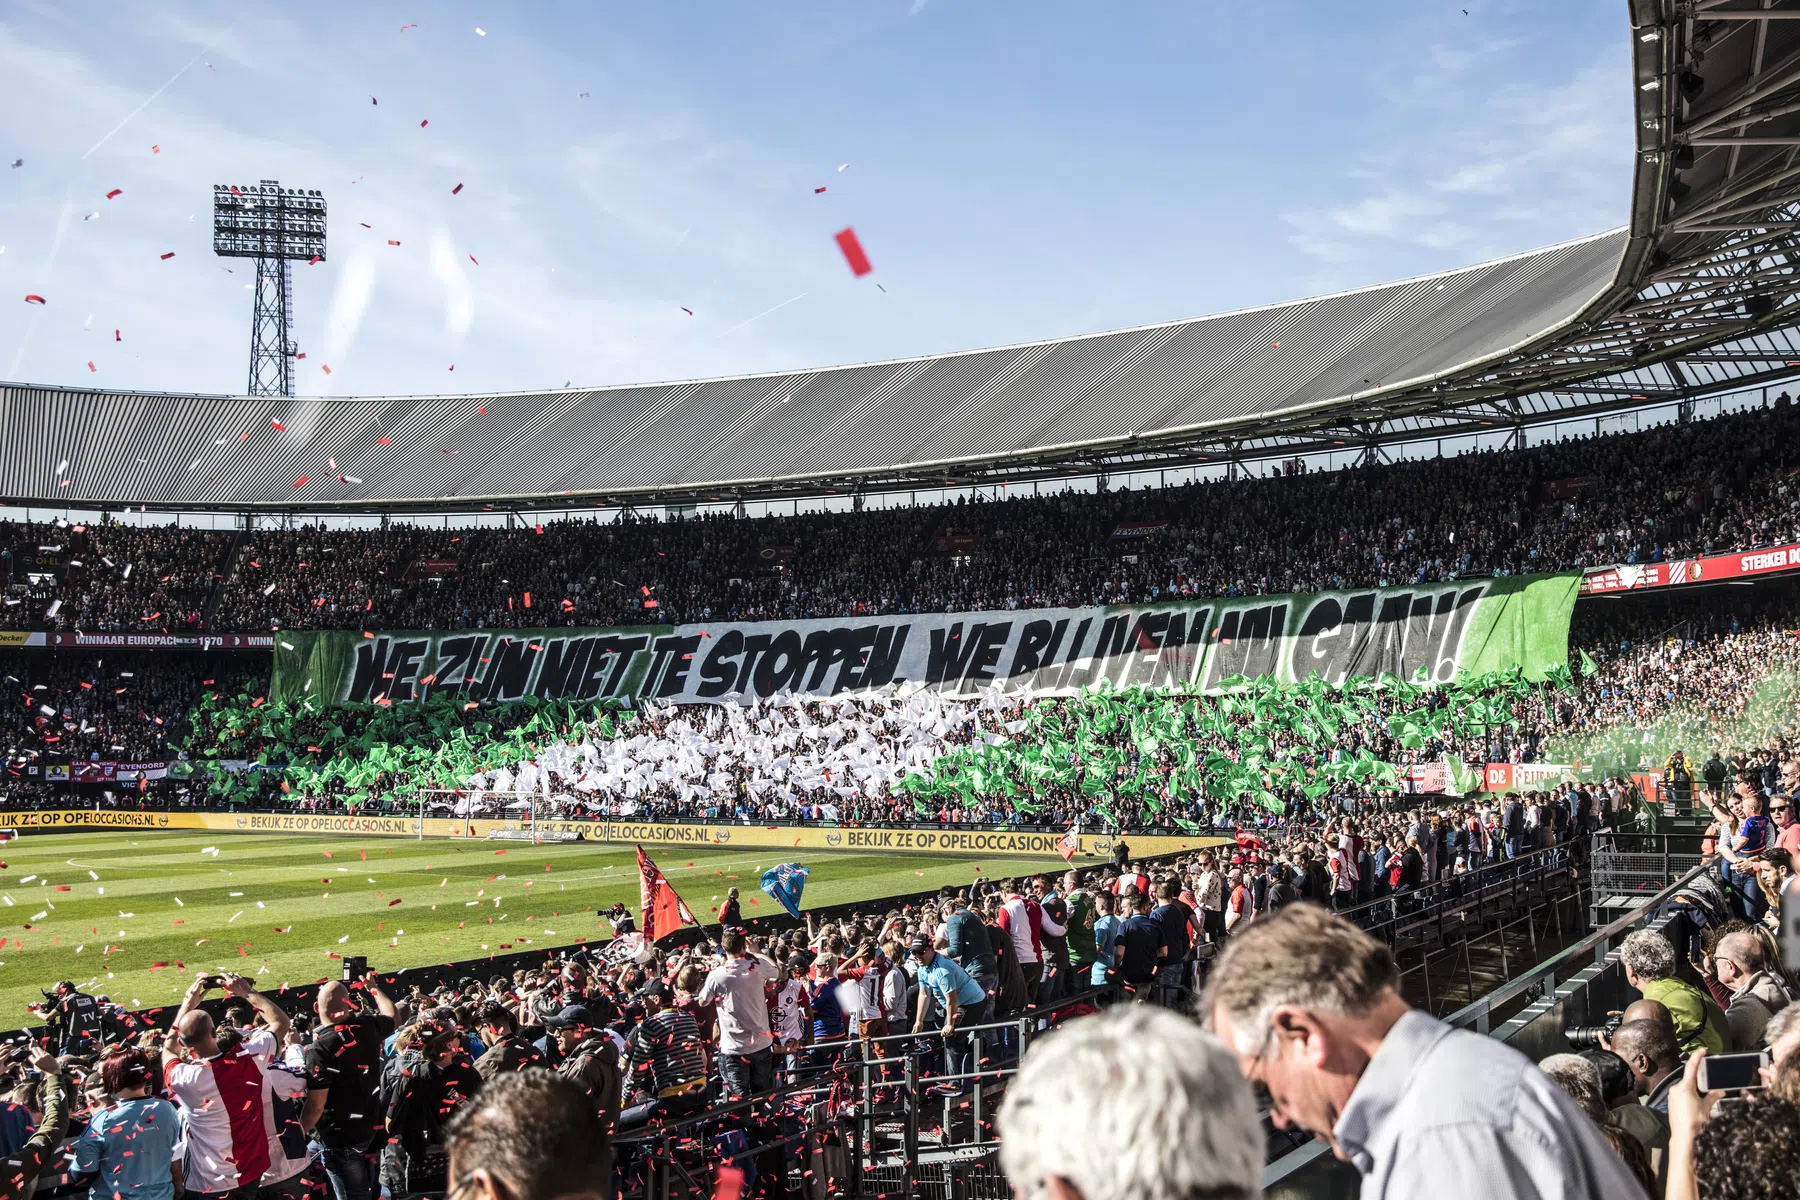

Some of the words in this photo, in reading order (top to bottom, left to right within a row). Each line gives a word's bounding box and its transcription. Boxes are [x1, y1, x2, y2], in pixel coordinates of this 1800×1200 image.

[1741, 551, 1787, 571] STERKER
[75, 635, 125, 645] WINNAAR
[198, 636, 223, 645] 1970
[247, 636, 274, 645] WINN
[349, 637, 430, 701] WE
[532, 635, 649, 699] NIET
[637, 634, 703, 699] TE
[925, 622, 1007, 694] WE
[117, 762, 164, 770] FEYENOORD
[1489, 769, 1506, 784] DE
[0, 813, 18, 827] IJK
[41, 813, 60, 824] OP
[64, 812, 155, 826] OPELOCCASIONS.NL
[251, 816, 281, 829] BEKIJK
[283, 817, 294, 828] ZE
[296, 818, 309, 829] OP
[311, 818, 407, 833] OPELOCCASIONS.NL
[596, 825, 711, 842] OPELOCCASIONS.NL
[848, 832, 893, 847] BEKIJK
[896, 833, 913, 847] ZE
[916, 834, 936, 849] OP
[81, 1011, 95, 1022] TV
